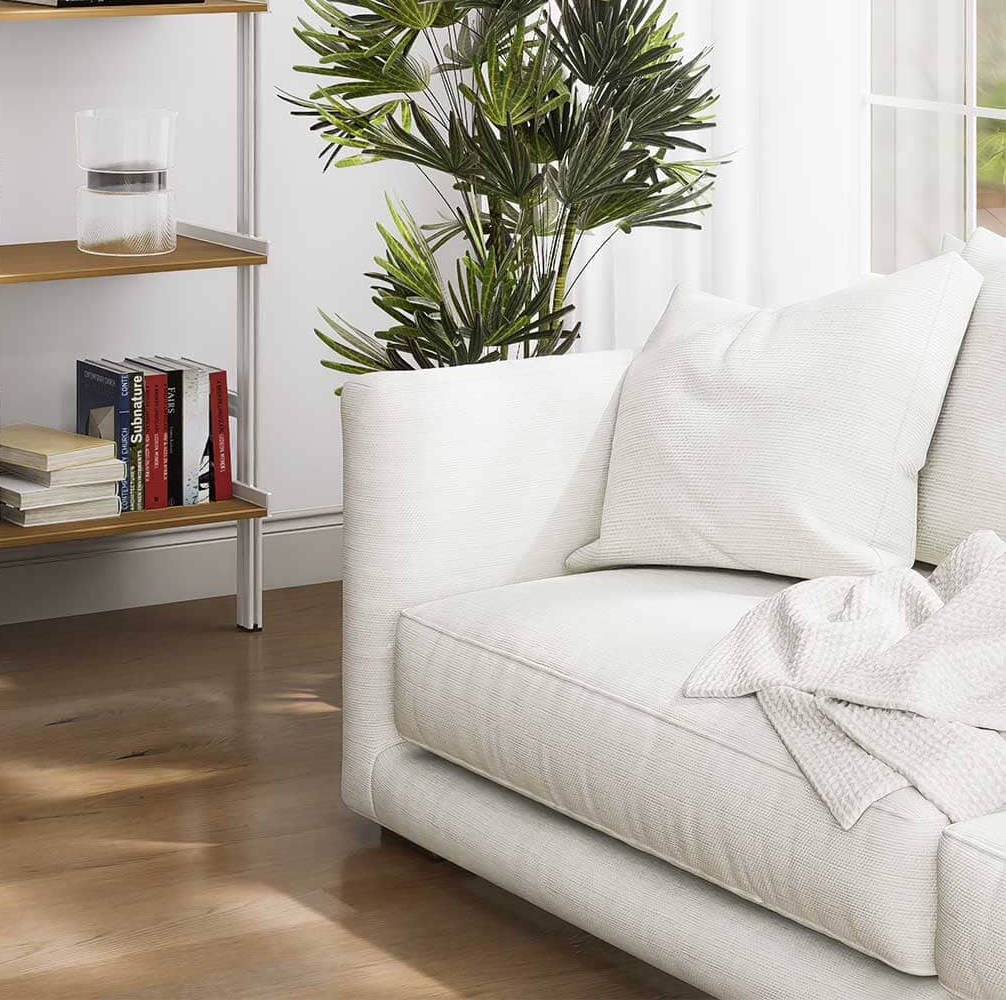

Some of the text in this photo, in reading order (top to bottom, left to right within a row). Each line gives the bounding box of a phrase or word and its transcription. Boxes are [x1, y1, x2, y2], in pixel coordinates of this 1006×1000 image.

[130, 375, 143, 444] Subnature
[167, 386, 176, 415] FAIRS
[120, 427, 128, 455] CHURCH
